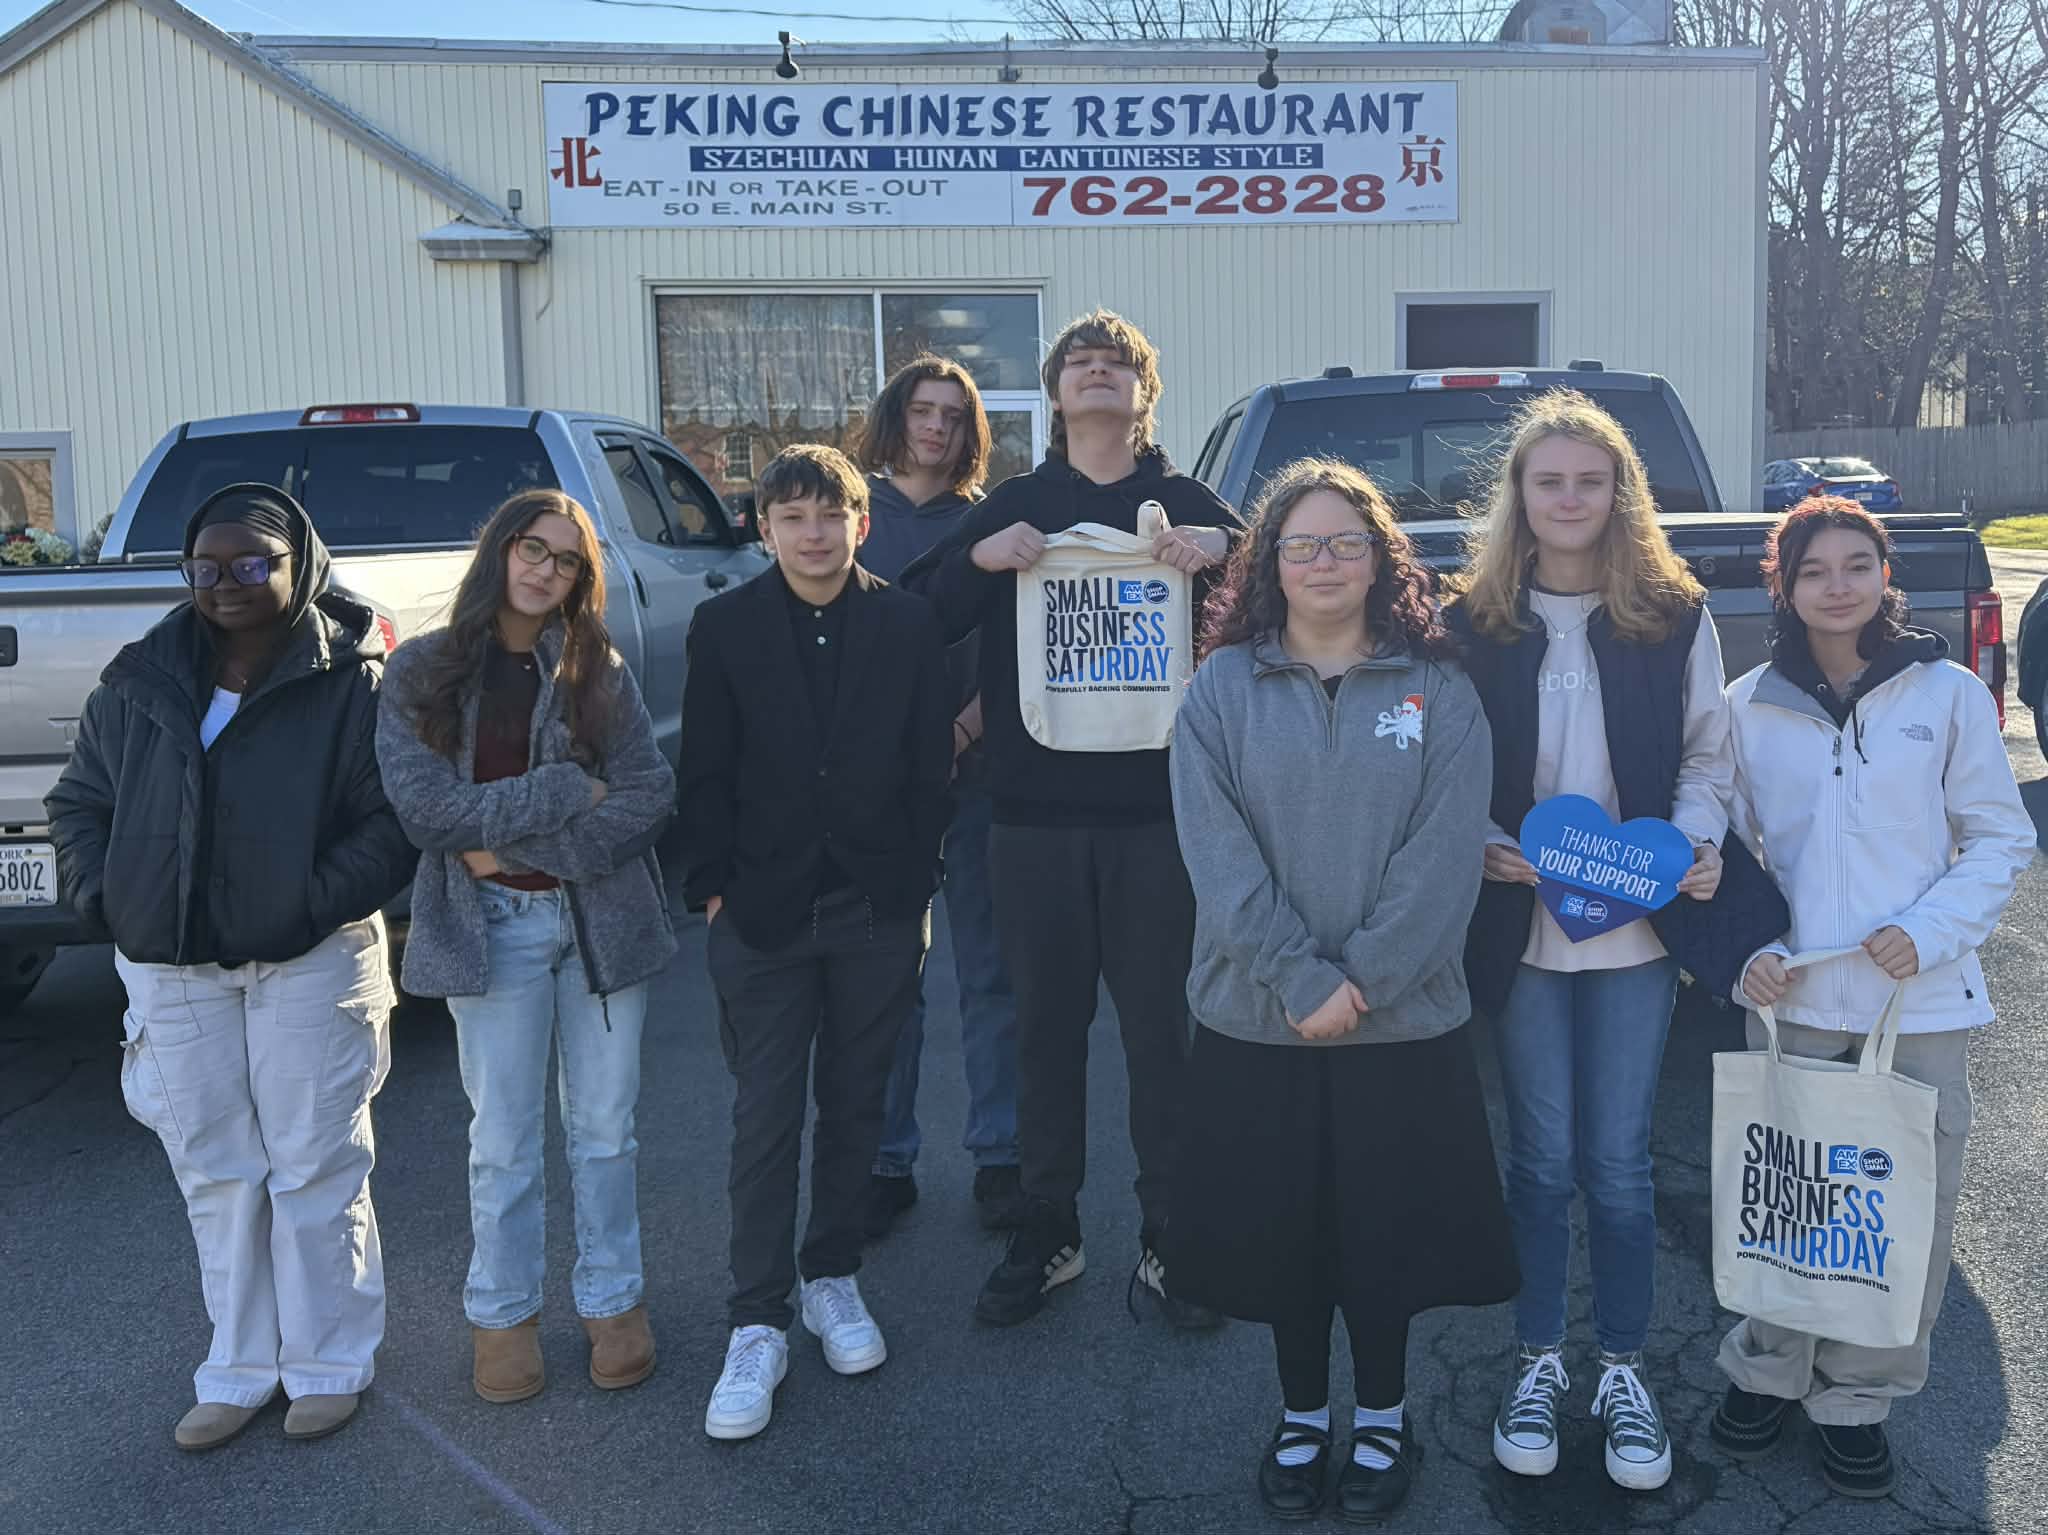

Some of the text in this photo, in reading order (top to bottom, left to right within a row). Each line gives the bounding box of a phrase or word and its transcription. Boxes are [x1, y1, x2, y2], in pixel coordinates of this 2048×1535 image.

[585, 91, 1424, 138] PEKING CHINESE RESTAURANT
[550, 136, 603, 189] 北
[703, 145, 1314, 170] SZECHUAN HUNAN CANTONESE STYLE
[1396, 134, 1447, 188] 京
[603, 179, 716, 197] EAT-IN
[776, 179, 949, 197] TAKE-OUT
[663, 202, 892, 216] 50 E. MAIN ST.
[1022, 173, 1387, 217] 762-2828
[1043, 576, 1119, 614] SMALL
[1046, 611, 1166, 648] BUSINESS
[1046, 646, 1171, 683] SATURDAY
[1122, 684, 1171, 692] COMMUNITIES
[1560, 825, 1654, 874] THANKS FOR
[1538, 846, 1661, 902] YOUR SUPPORT
[1743, 1122, 1829, 1184] SMALL
[1834, 1149, 1858, 1160] AM
[1837, 1159, 1857, 1170] EX
[1741, 1164, 1885, 1234] BUSINESS
[1738, 1206, 1890, 1278] SATURDAY
[1736, 1251, 1891, 1293] POWERFULLY BACKING COMMUNITIES
